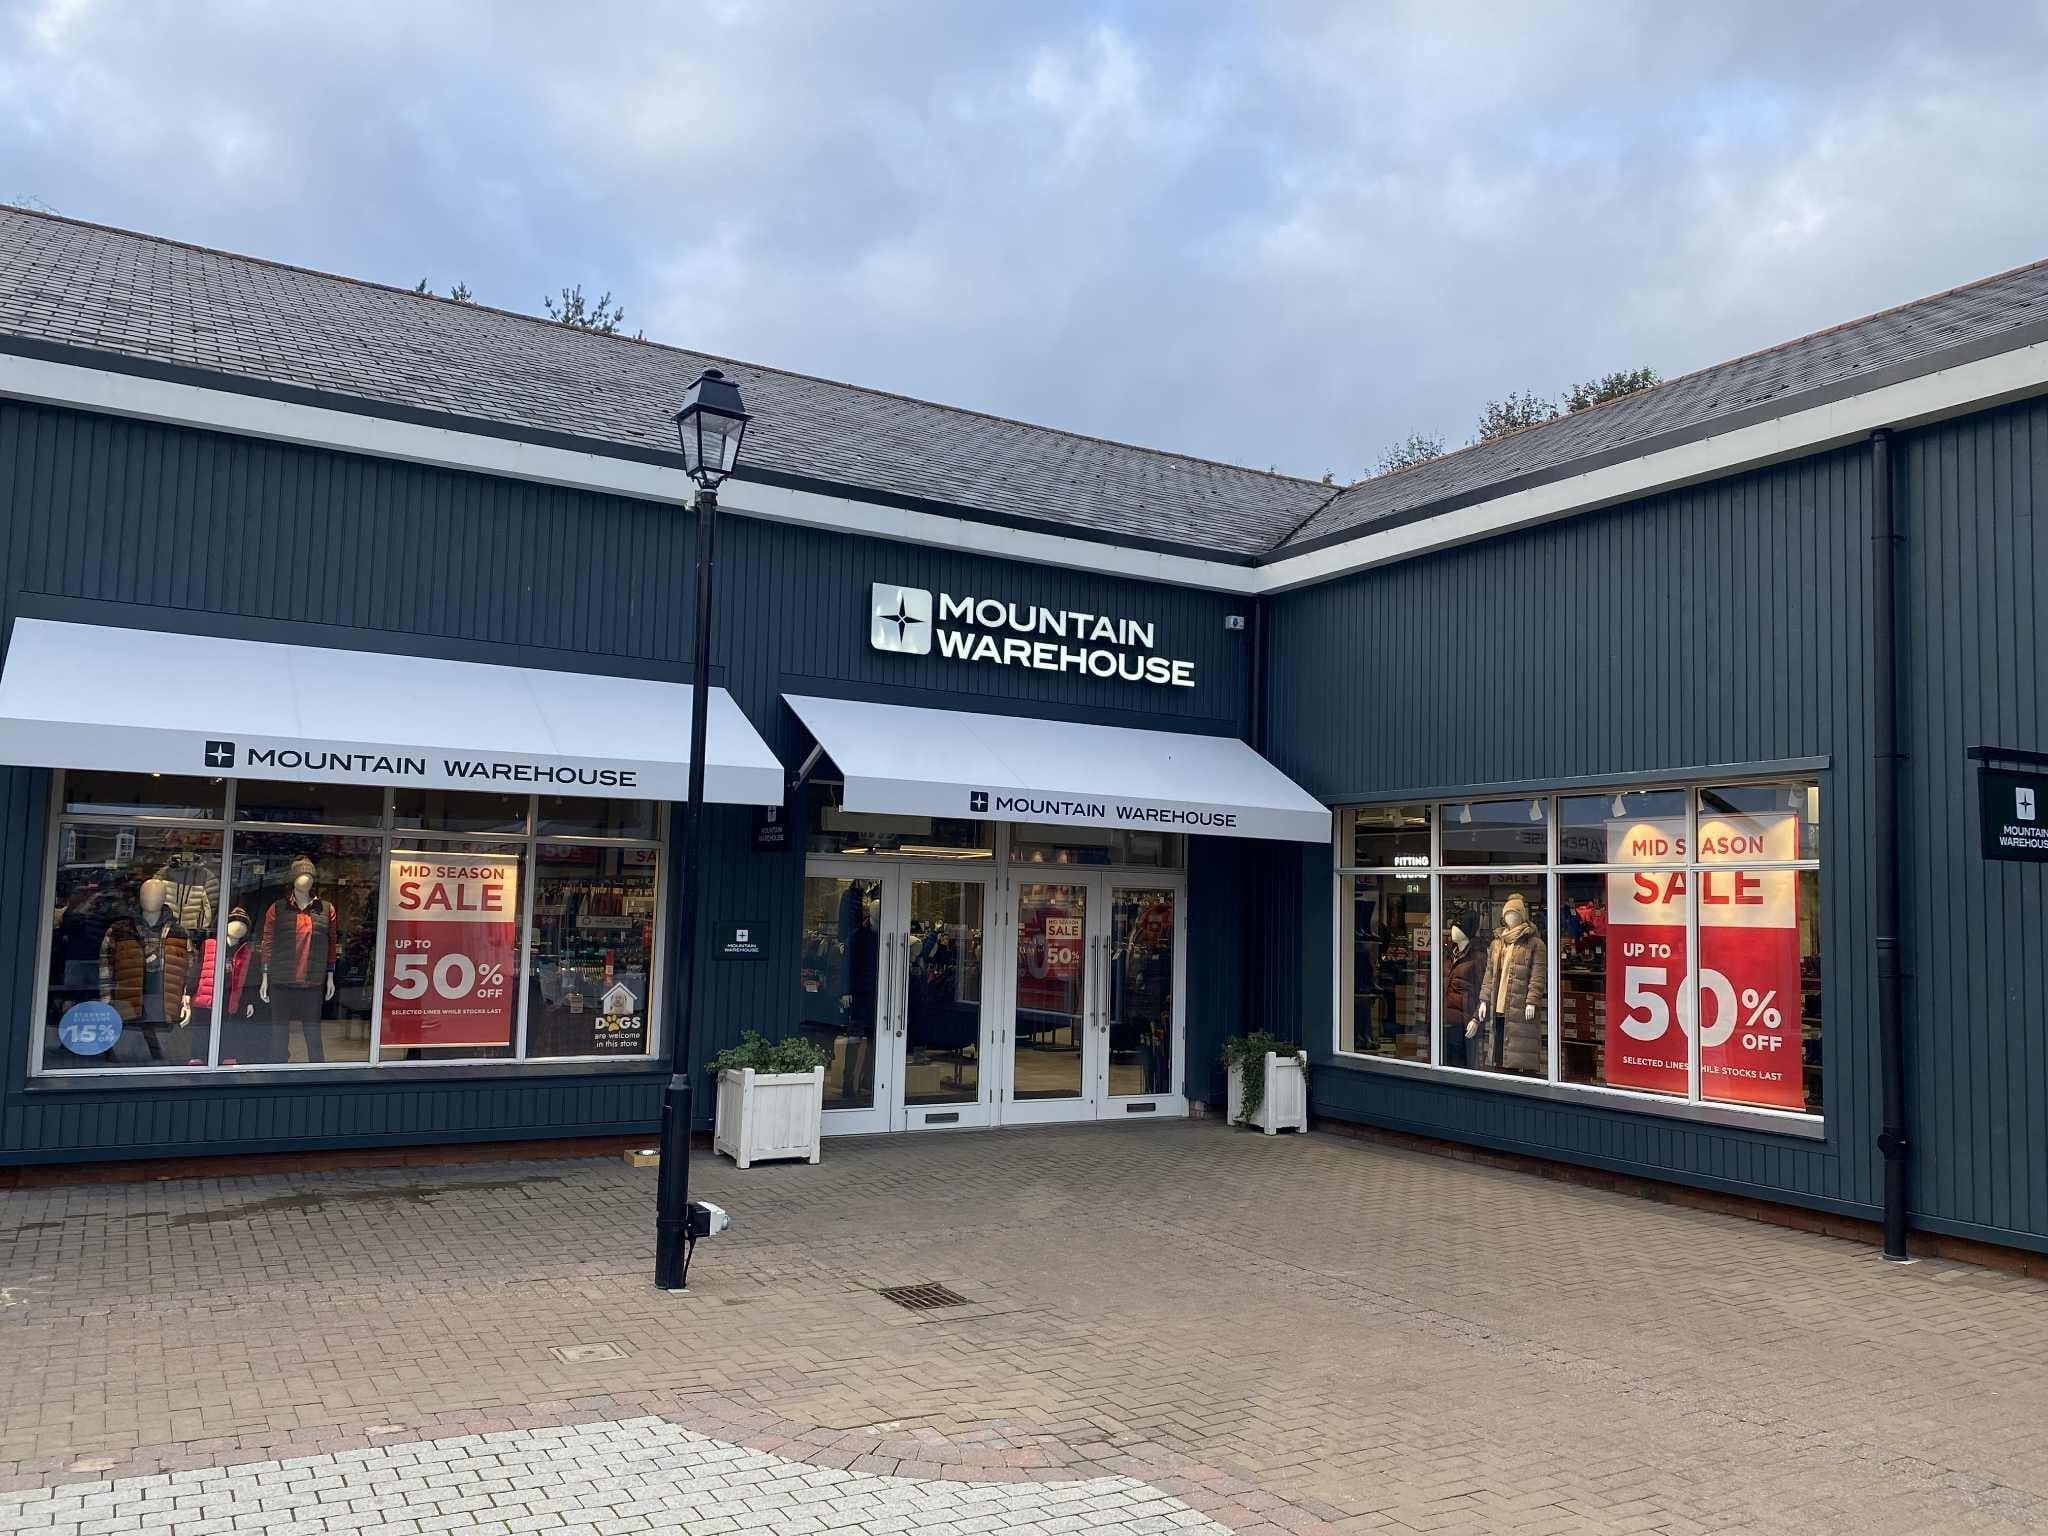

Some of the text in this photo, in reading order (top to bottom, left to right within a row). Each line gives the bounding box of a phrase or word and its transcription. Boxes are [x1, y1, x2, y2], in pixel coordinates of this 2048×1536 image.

[939, 593, 1154, 648] MOUNTAIN
[936, 629, 1195, 687] WAREHOUSE
[247, 748, 638, 787] MOUNTAIN WAREHOUSE
[996, 797, 1236, 827] MOUNTAIN WAREHOUSE
[2003, 825, 2048, 837] MOUNTAIN
[1632, 836, 1764, 856] MID SASON
[2000, 837, 2048, 848] WAREHOUS
[1394, 856, 1429, 866] FITTING
[400, 865, 505, 879] MID SEASON
[398, 882, 504, 911] SALE
[1633, 871, 1763, 904] SALE
[1048, 926, 1079, 936] SALE
[395, 940, 432, 949] UP TO
[1623, 943, 1671, 958] UP TO
[389, 953, 504, 1000] 50%
[477, 989, 504, 998] OFF
[1620, 965, 1782, 1047] 50%
[594, 1015, 641, 1030] DGS
[608, 1031, 640, 1040] welcome
[1742, 1033, 1783, 1051] OFF
[1623, 1056, 1783, 1081] SELECTED LINES HILE STOCKS LAST
